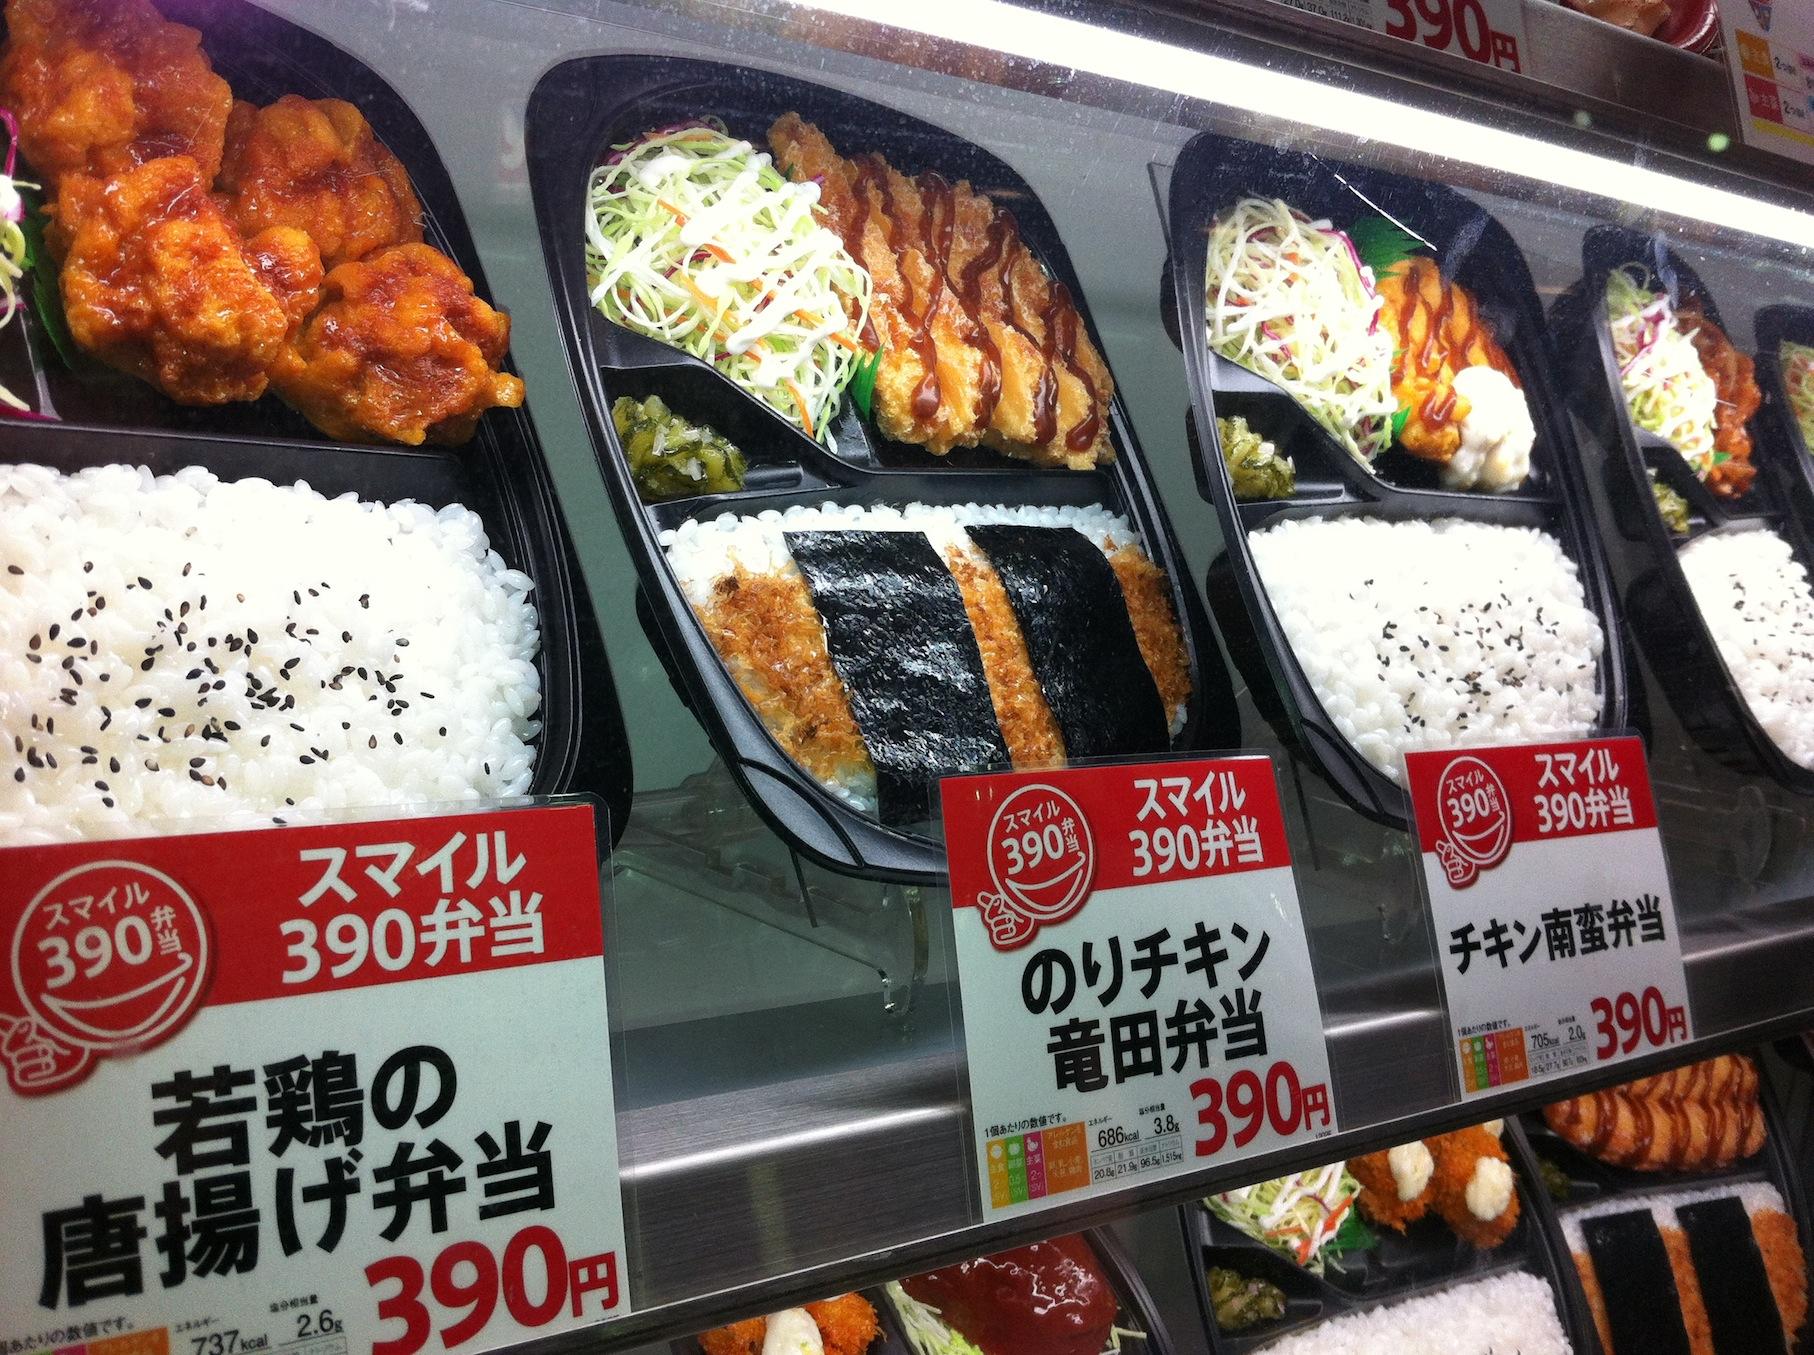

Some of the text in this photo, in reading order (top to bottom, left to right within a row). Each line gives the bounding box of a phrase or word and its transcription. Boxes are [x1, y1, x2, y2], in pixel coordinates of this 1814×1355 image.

[1133, 770, 1246, 822] スマイル
[1446, 769, 1484, 794] スマイル
[1534, 748, 1619, 788] スマイル
[1003, 799, 1060, 833] スマイル
[1447, 787, 1490, 828] 390
[1534, 785, 1635, 833] 390弁当
[299, 830, 527, 906] スマイル
[1001, 816, 1081, 875] 390 弁当
[1128, 816, 1264, 877] 390弁当
[43, 882, 150, 930] スマイル
[1449, 893, 1666, 975] チキン南蛮弁当
[37, 904, 183, 989] 390 弁当
[279, 890, 546, 985] 390弁当
[1021, 921, 1270, 1015] のりチキン
[1047, 987, 1268, 1093] 竜田弁当
[1590, 985, 1688, 1060] 390円
[151, 1044, 458, 1175] 若鶏の
[984, 1112, 1067, 1138] 1個あたりの数値です。
[1098, 1126, 1139, 1148] 686kcal
[1153, 1114, 1180, 1134] 3.8g
[1189, 1060, 1331, 1157] 390円
[38, 1120, 557, 1312] 唐揚げ弁当
[364, 1224, 621, 1355] 390円
[191, 1329, 268, 1355] 737kcal
[297, 1309, 344, 1338] 2.6g
